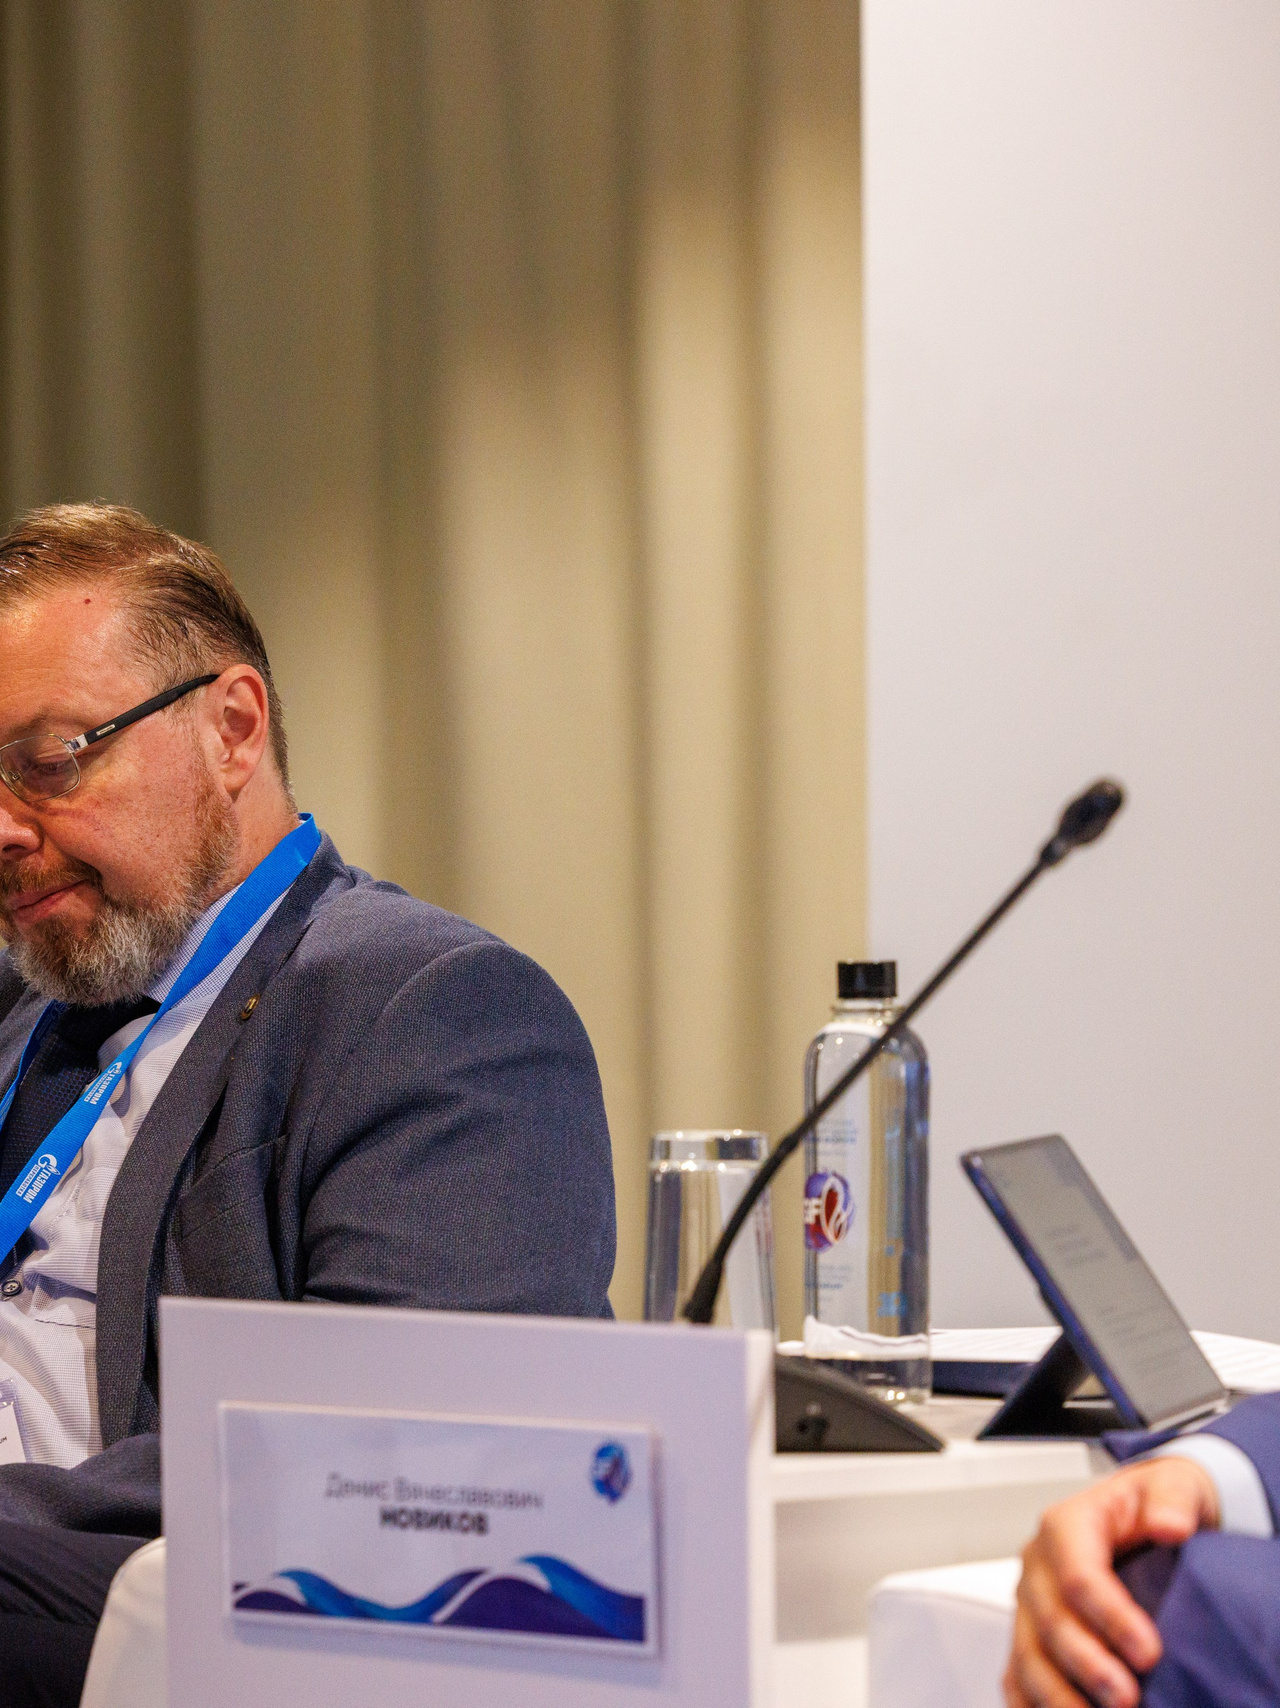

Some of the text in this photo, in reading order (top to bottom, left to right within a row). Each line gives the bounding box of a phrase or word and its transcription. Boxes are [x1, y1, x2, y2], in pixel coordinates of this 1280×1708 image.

[90, 1073, 115, 1104] ГАЗПРОМ
[23, 1168, 52, 1204] ГАЗПРОМ
[325, 1471, 390, 1500] Денис
[379, 1503, 488, 1536] НОВИКОВ
